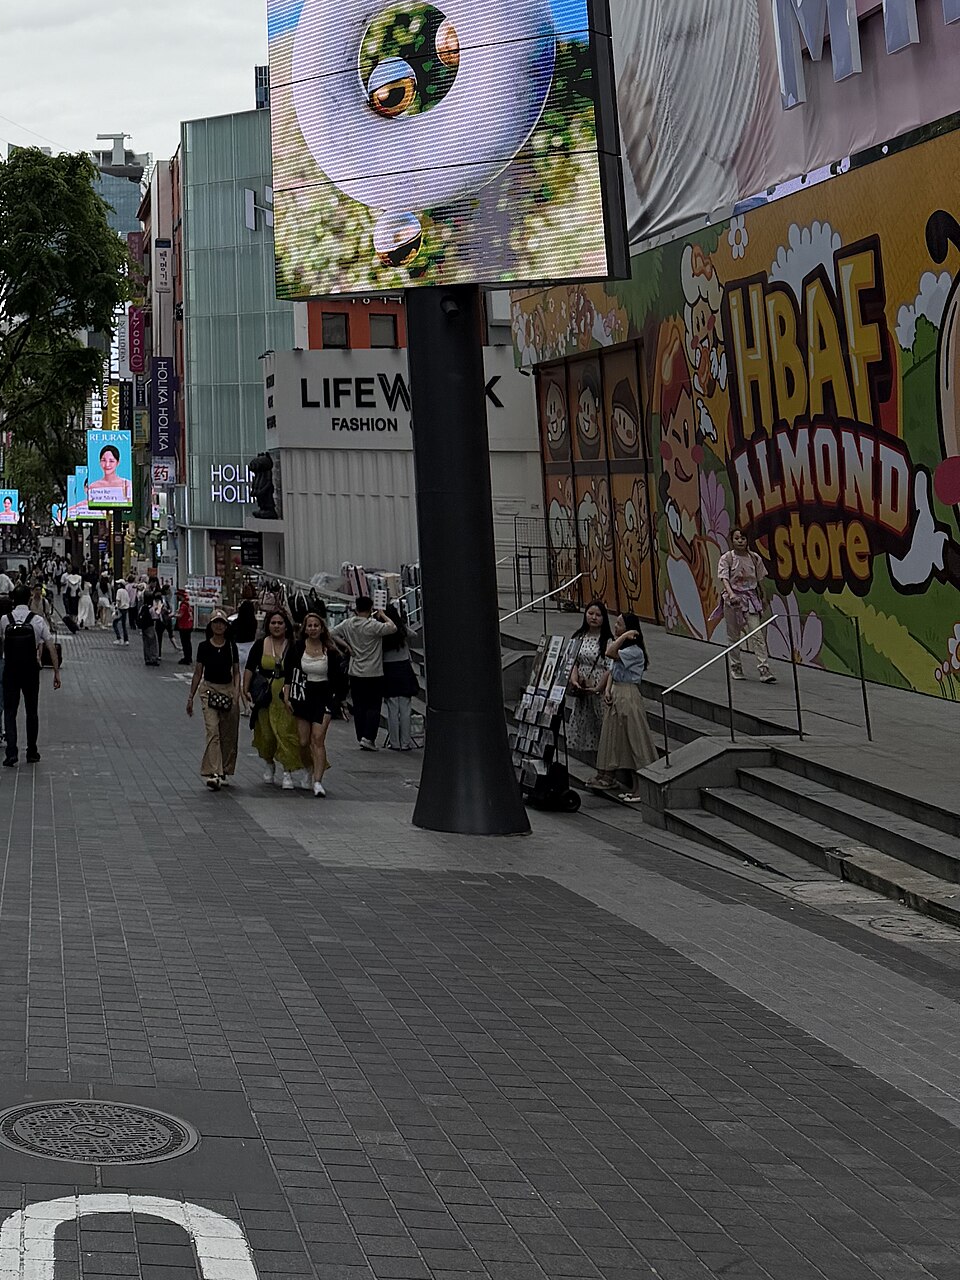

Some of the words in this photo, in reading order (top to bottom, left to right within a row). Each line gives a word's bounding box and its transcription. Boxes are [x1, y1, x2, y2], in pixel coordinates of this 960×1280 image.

[729, 250, 882, 440] HBAF
[158, 361, 168, 402] HOLIKA
[301, 372, 504, 411] LIFEWK
[158, 407, 168, 451] HOLIKA
[331, 417, 398, 432] FASHION
[154, 465, 168, 481] 药
[736, 427, 911, 534] ALMOND
[775, 513, 871, 580] store
